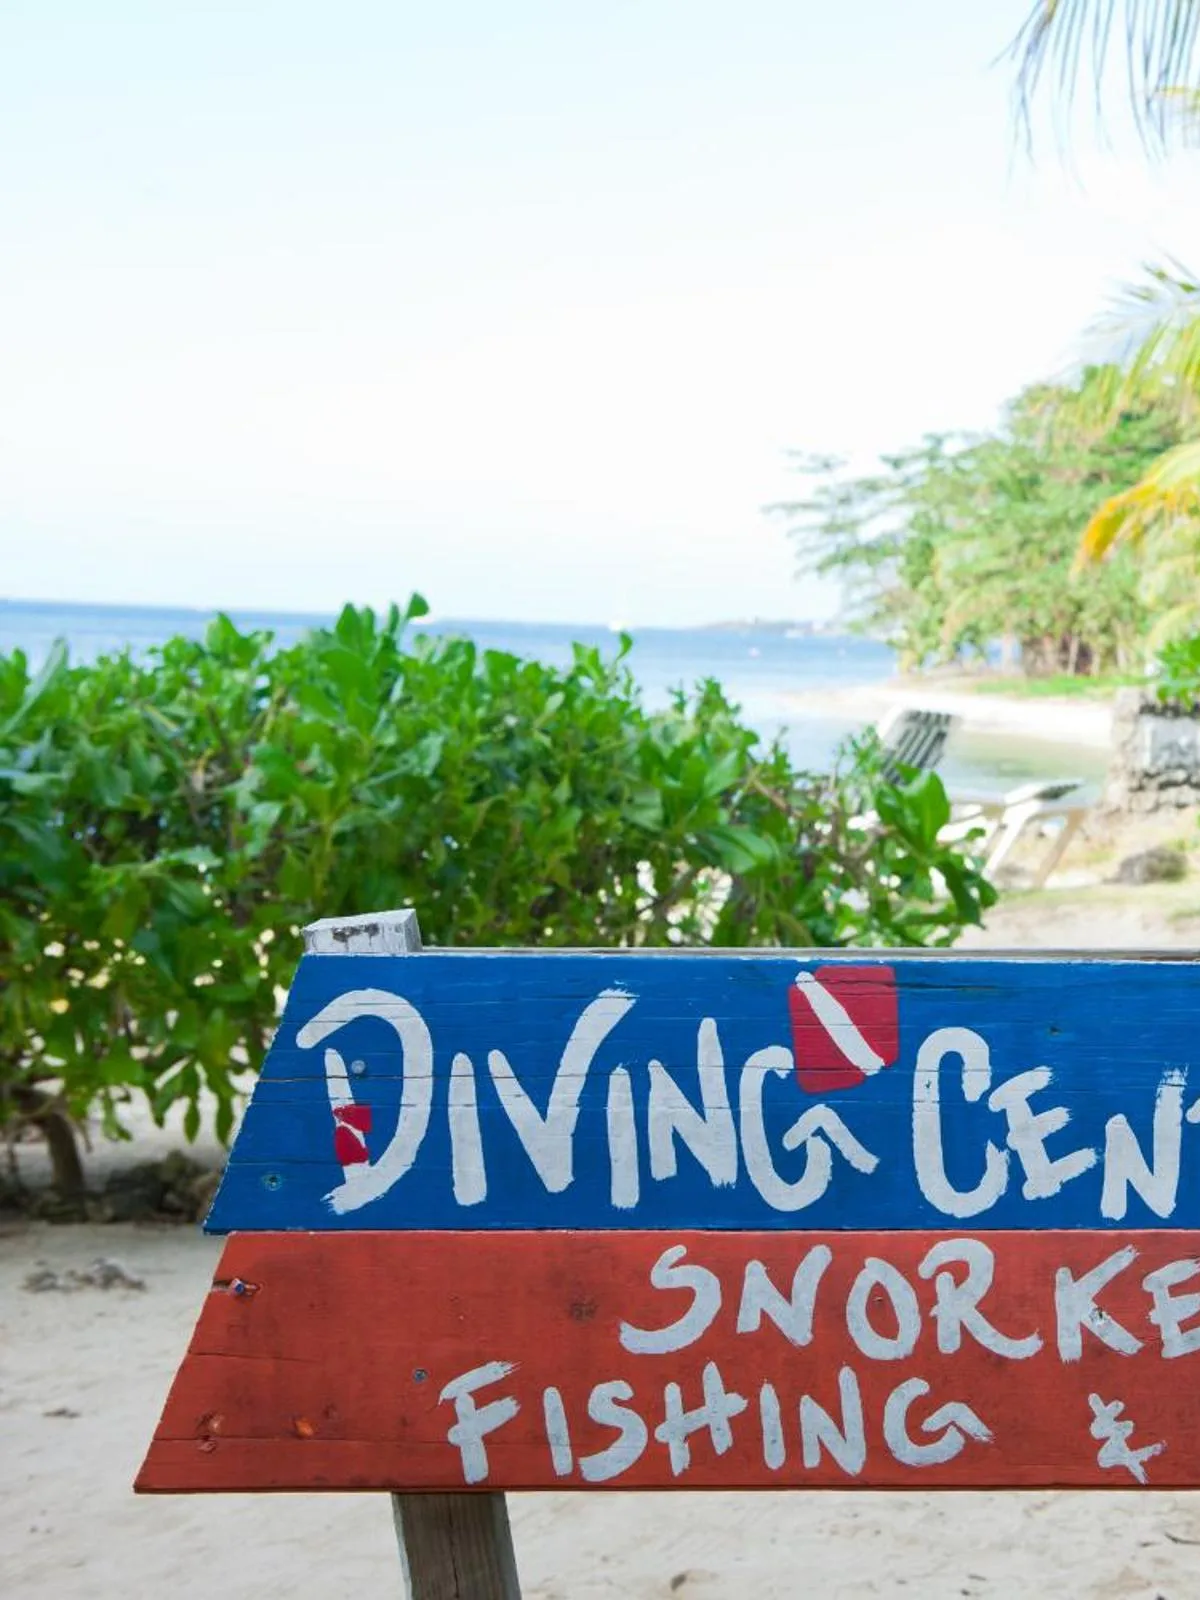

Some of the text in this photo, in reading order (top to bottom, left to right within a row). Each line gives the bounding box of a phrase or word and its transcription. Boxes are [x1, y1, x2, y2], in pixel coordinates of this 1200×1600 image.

[295, 988, 880, 1215] DIVING
[438, 1361, 995, 1485] FISHING
[1088, 1392, 1166, 1485] &
